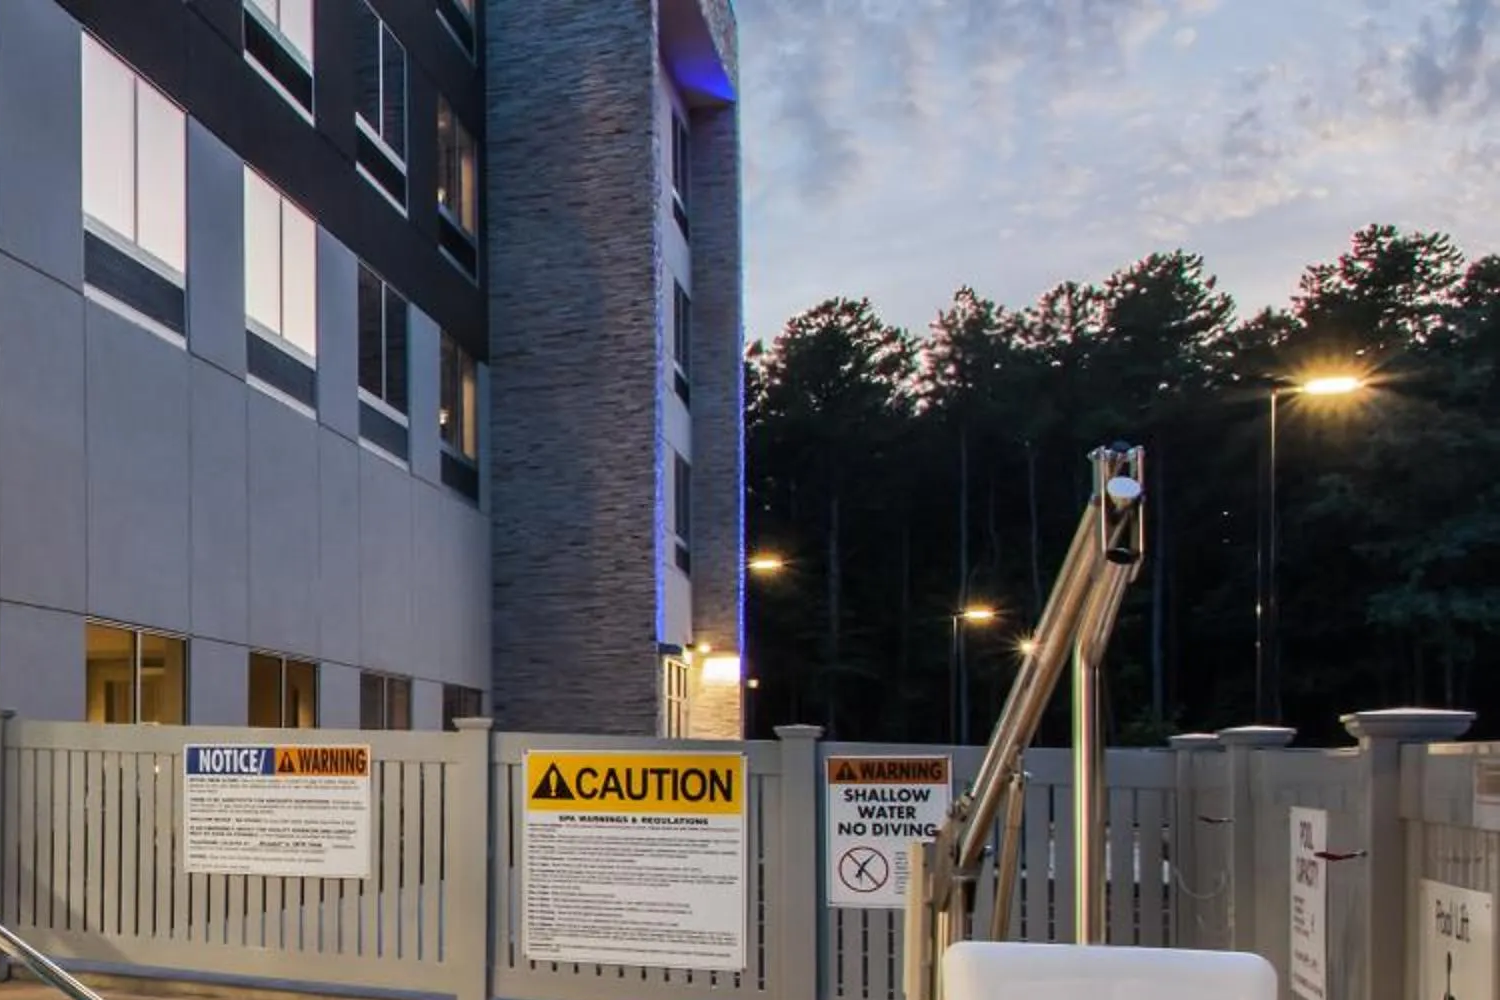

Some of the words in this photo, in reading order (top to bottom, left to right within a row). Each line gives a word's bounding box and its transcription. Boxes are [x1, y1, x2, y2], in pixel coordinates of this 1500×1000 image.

[299, 748, 367, 775] WARNING
[859, 761, 942, 780] WARNING
[575, 768, 733, 802] CAUTION
[844, 788, 931, 803] SHALLOW
[558, 815, 576, 823] SPA
[578, 815, 629, 824] WARNINGS
[641, 816, 709, 825] REGULATIONS
[858, 805, 917, 820] WATER
[838, 821, 866, 836] NO
[872, 822, 939, 837] DIVING
